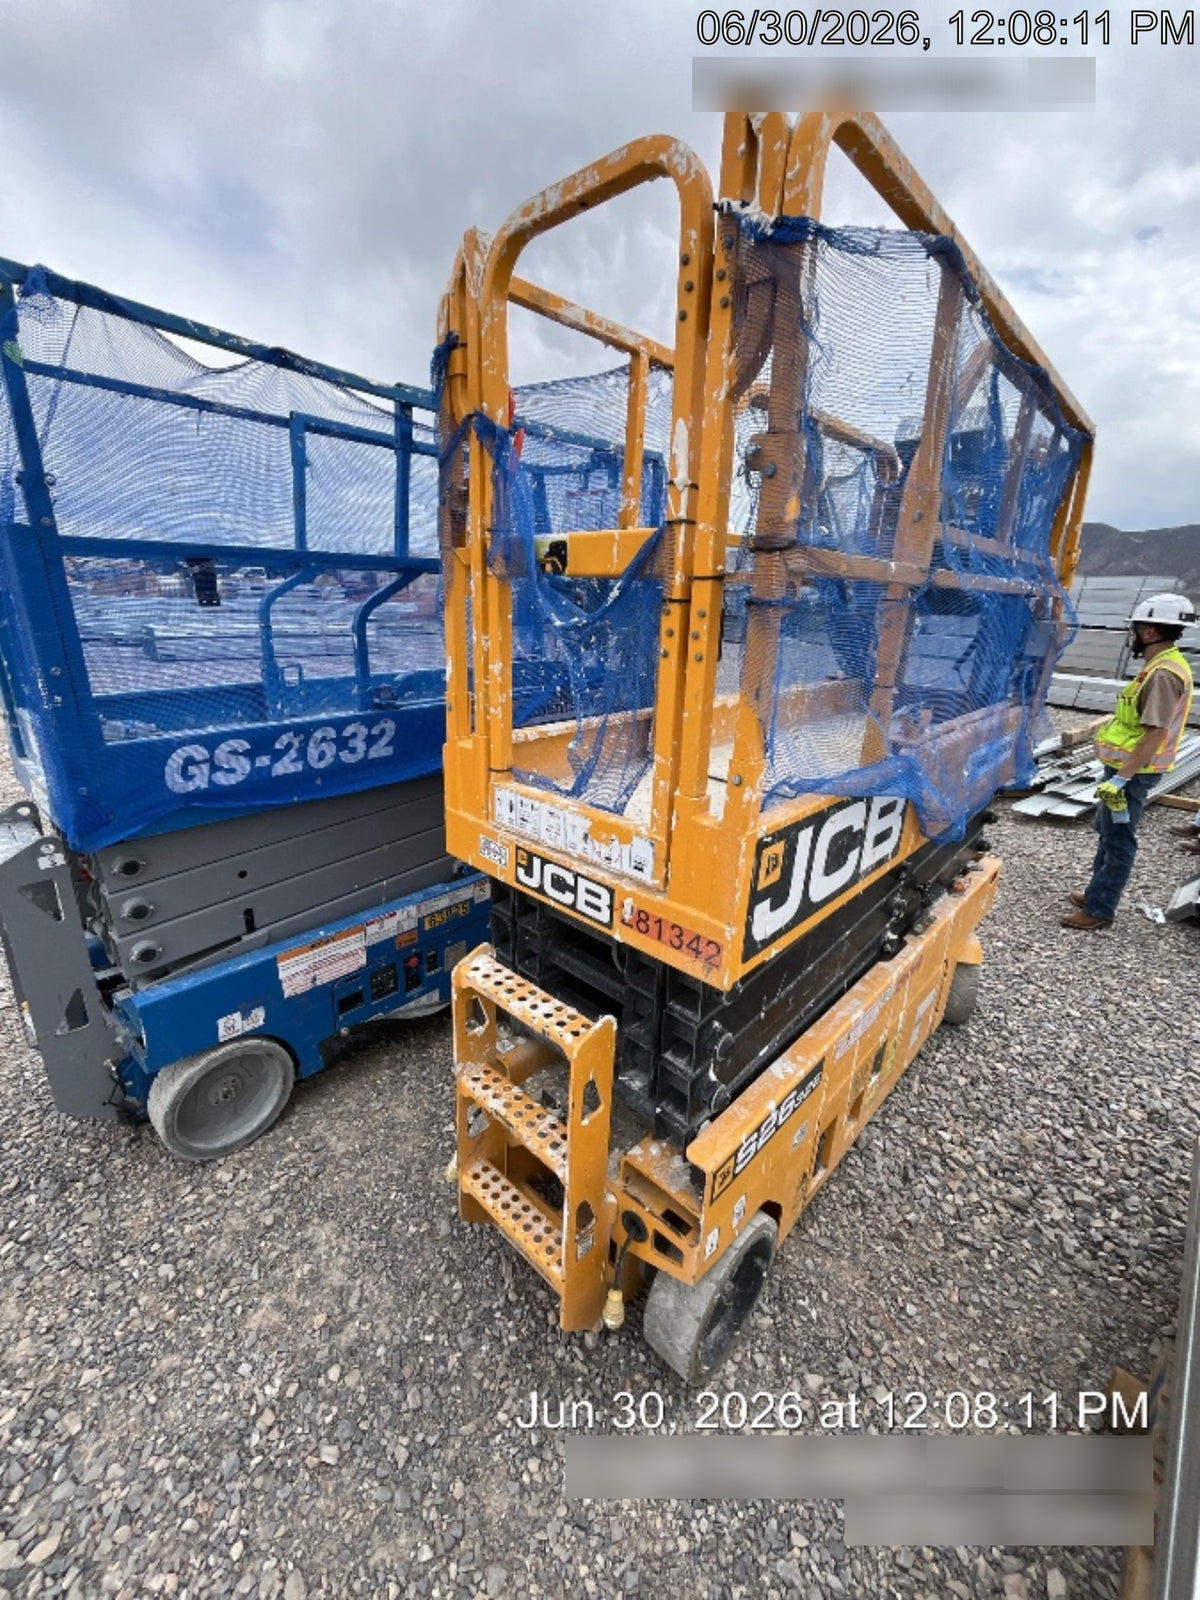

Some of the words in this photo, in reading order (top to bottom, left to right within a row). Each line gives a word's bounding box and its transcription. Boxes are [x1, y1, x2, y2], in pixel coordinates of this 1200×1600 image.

[164, 718, 396, 793] GS-2632
[516, 854, 611, 925] JCB
[751, 796, 906, 942] JCB
